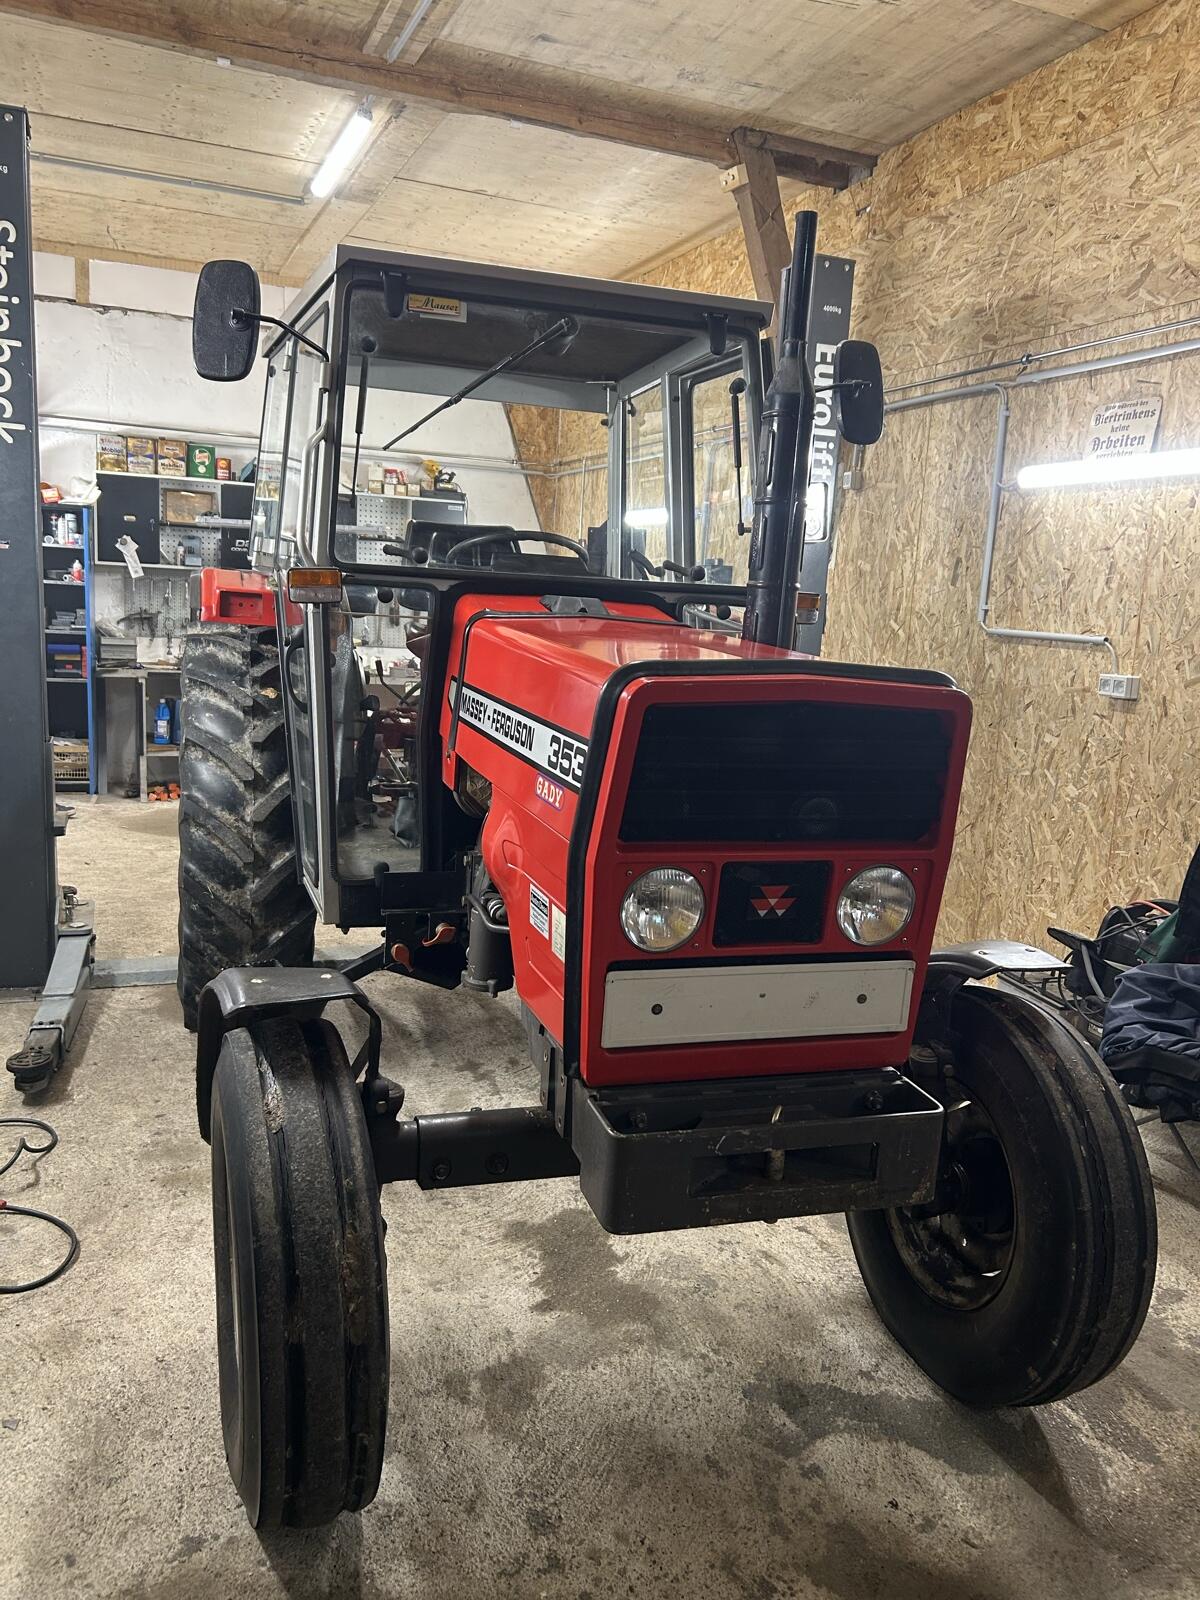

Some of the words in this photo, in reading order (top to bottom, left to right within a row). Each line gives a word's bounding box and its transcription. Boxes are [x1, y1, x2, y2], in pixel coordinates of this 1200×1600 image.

[810, 342, 837, 482] Eurolift
[1094, 408, 1156, 426] Biertrinkens
[1110, 424, 1130, 433] keine
[1092, 434, 1145, 452] Arbeiten
[547, 734, 587, 782] 353
[536, 776, 563, 809] GADY
